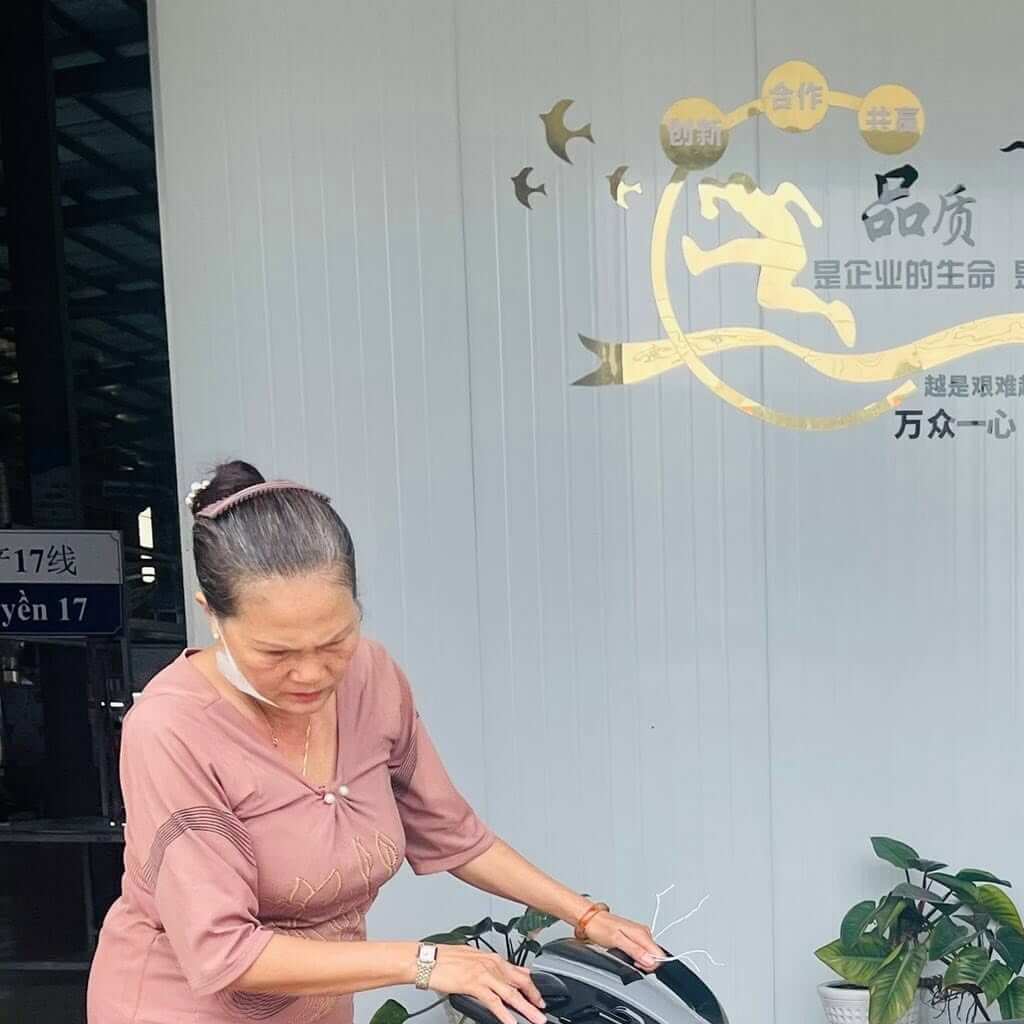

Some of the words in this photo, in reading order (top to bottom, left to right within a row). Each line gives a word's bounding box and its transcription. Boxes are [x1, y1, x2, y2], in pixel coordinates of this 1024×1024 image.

[769, 81, 824, 111] 合作
[669, 117, 722, 146] 创新
[861, 164, 976, 247] 品质
[813, 259, 996, 290] 是企业的生命
[894, 408, 1017, 440] 万众一心
[59, 597, 88, 622] 17
